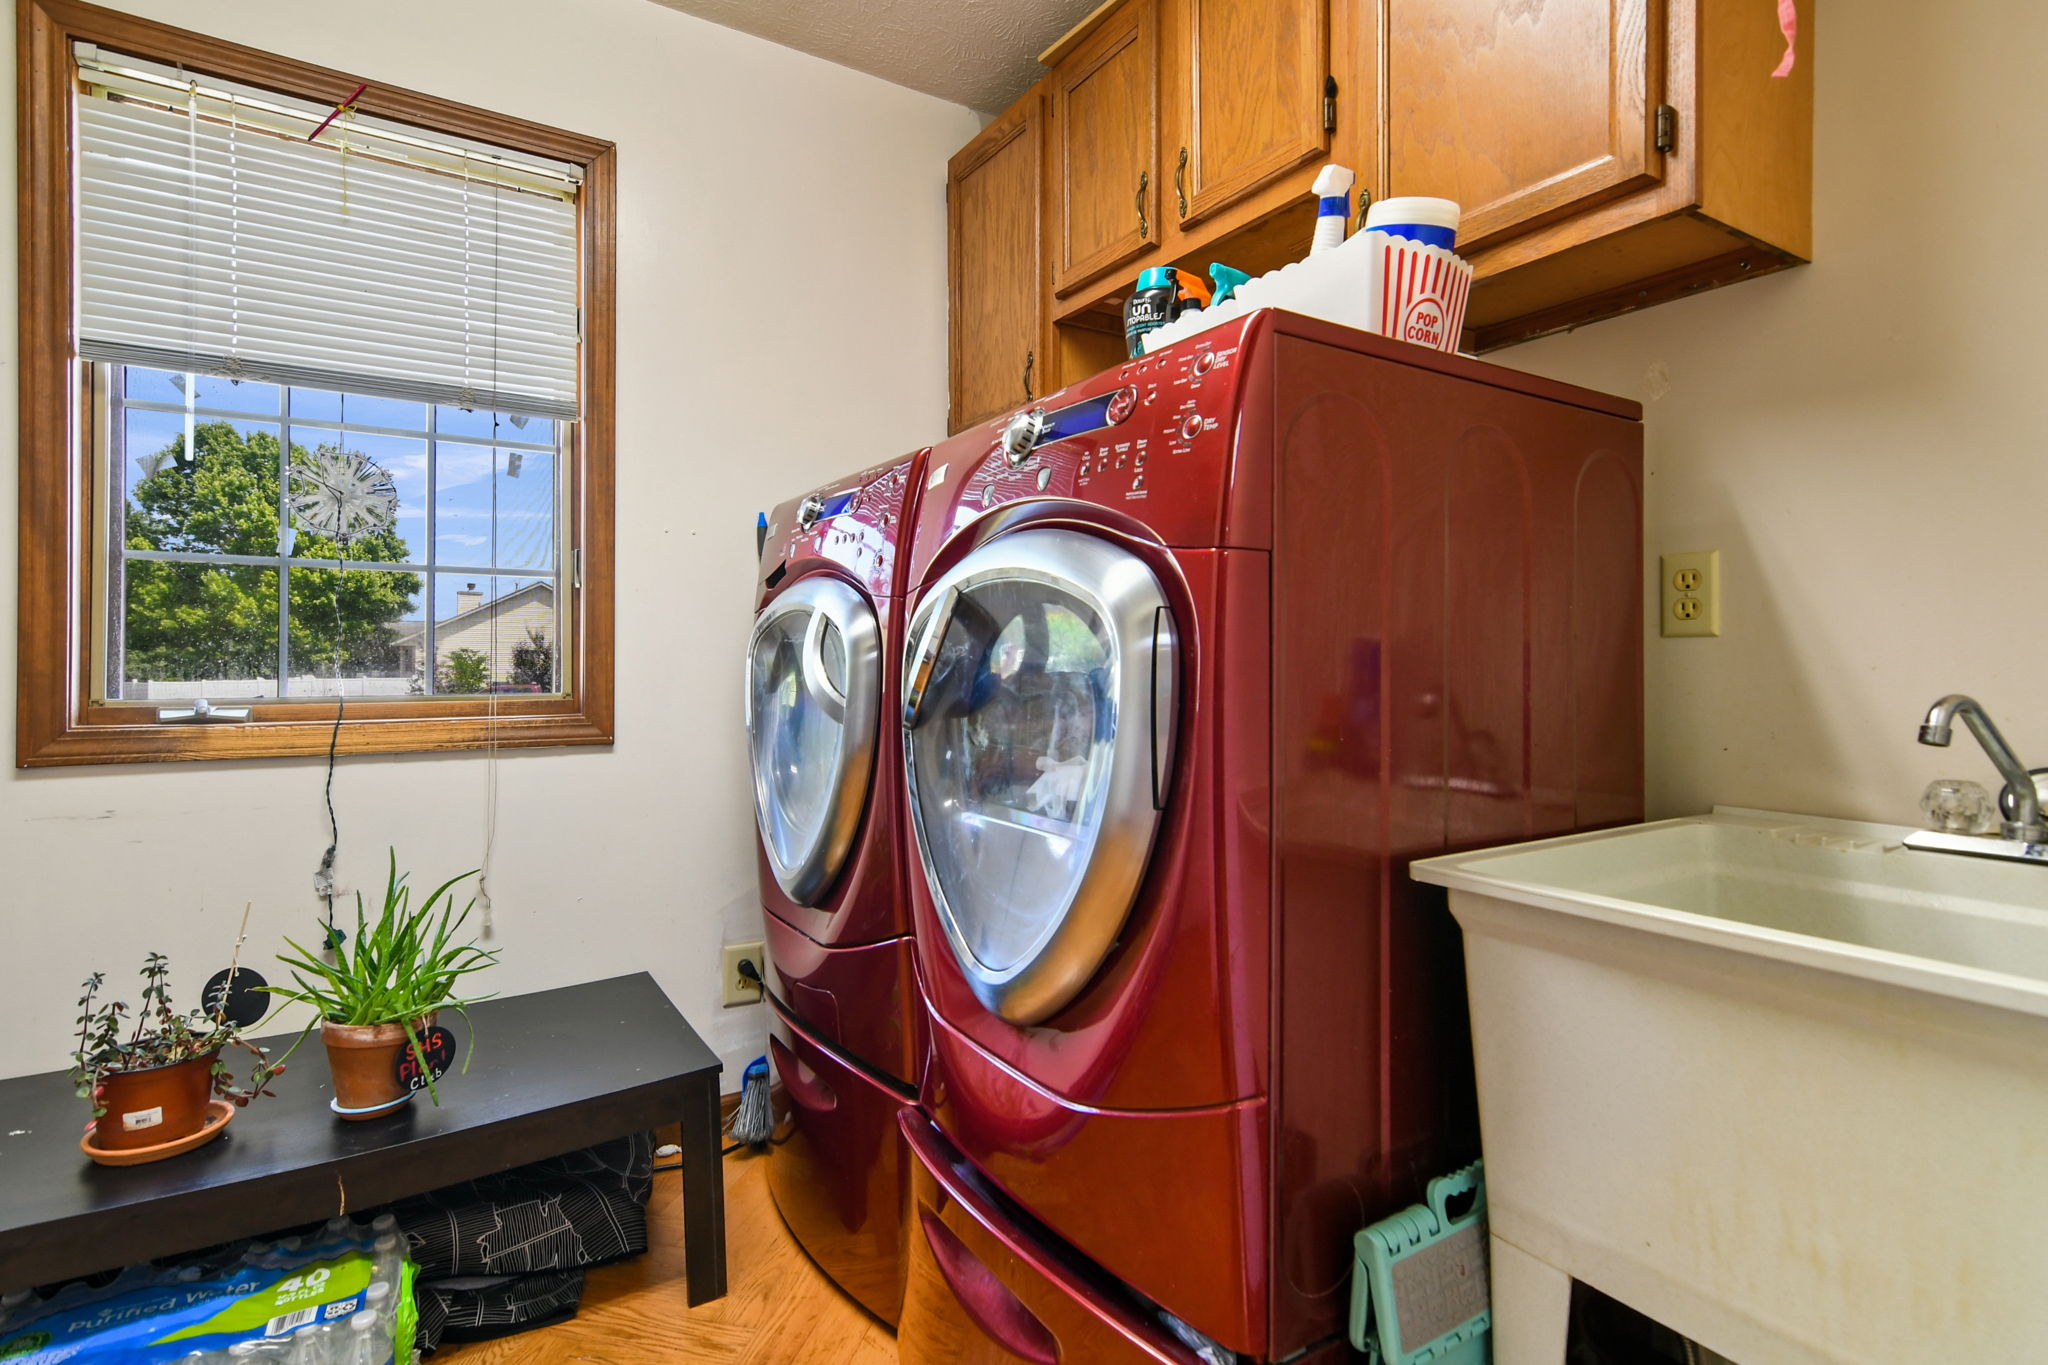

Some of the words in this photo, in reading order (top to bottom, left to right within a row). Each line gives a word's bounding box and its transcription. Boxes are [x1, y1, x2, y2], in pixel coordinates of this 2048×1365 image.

[1127, 312, 1164, 327] STOPABLES
[1416, 312, 1438, 328] POP
[1408, 326, 1439, 345] CORN
[276, 1267, 331, 1292] 40
[68, 1297, 177, 1334] Purified
